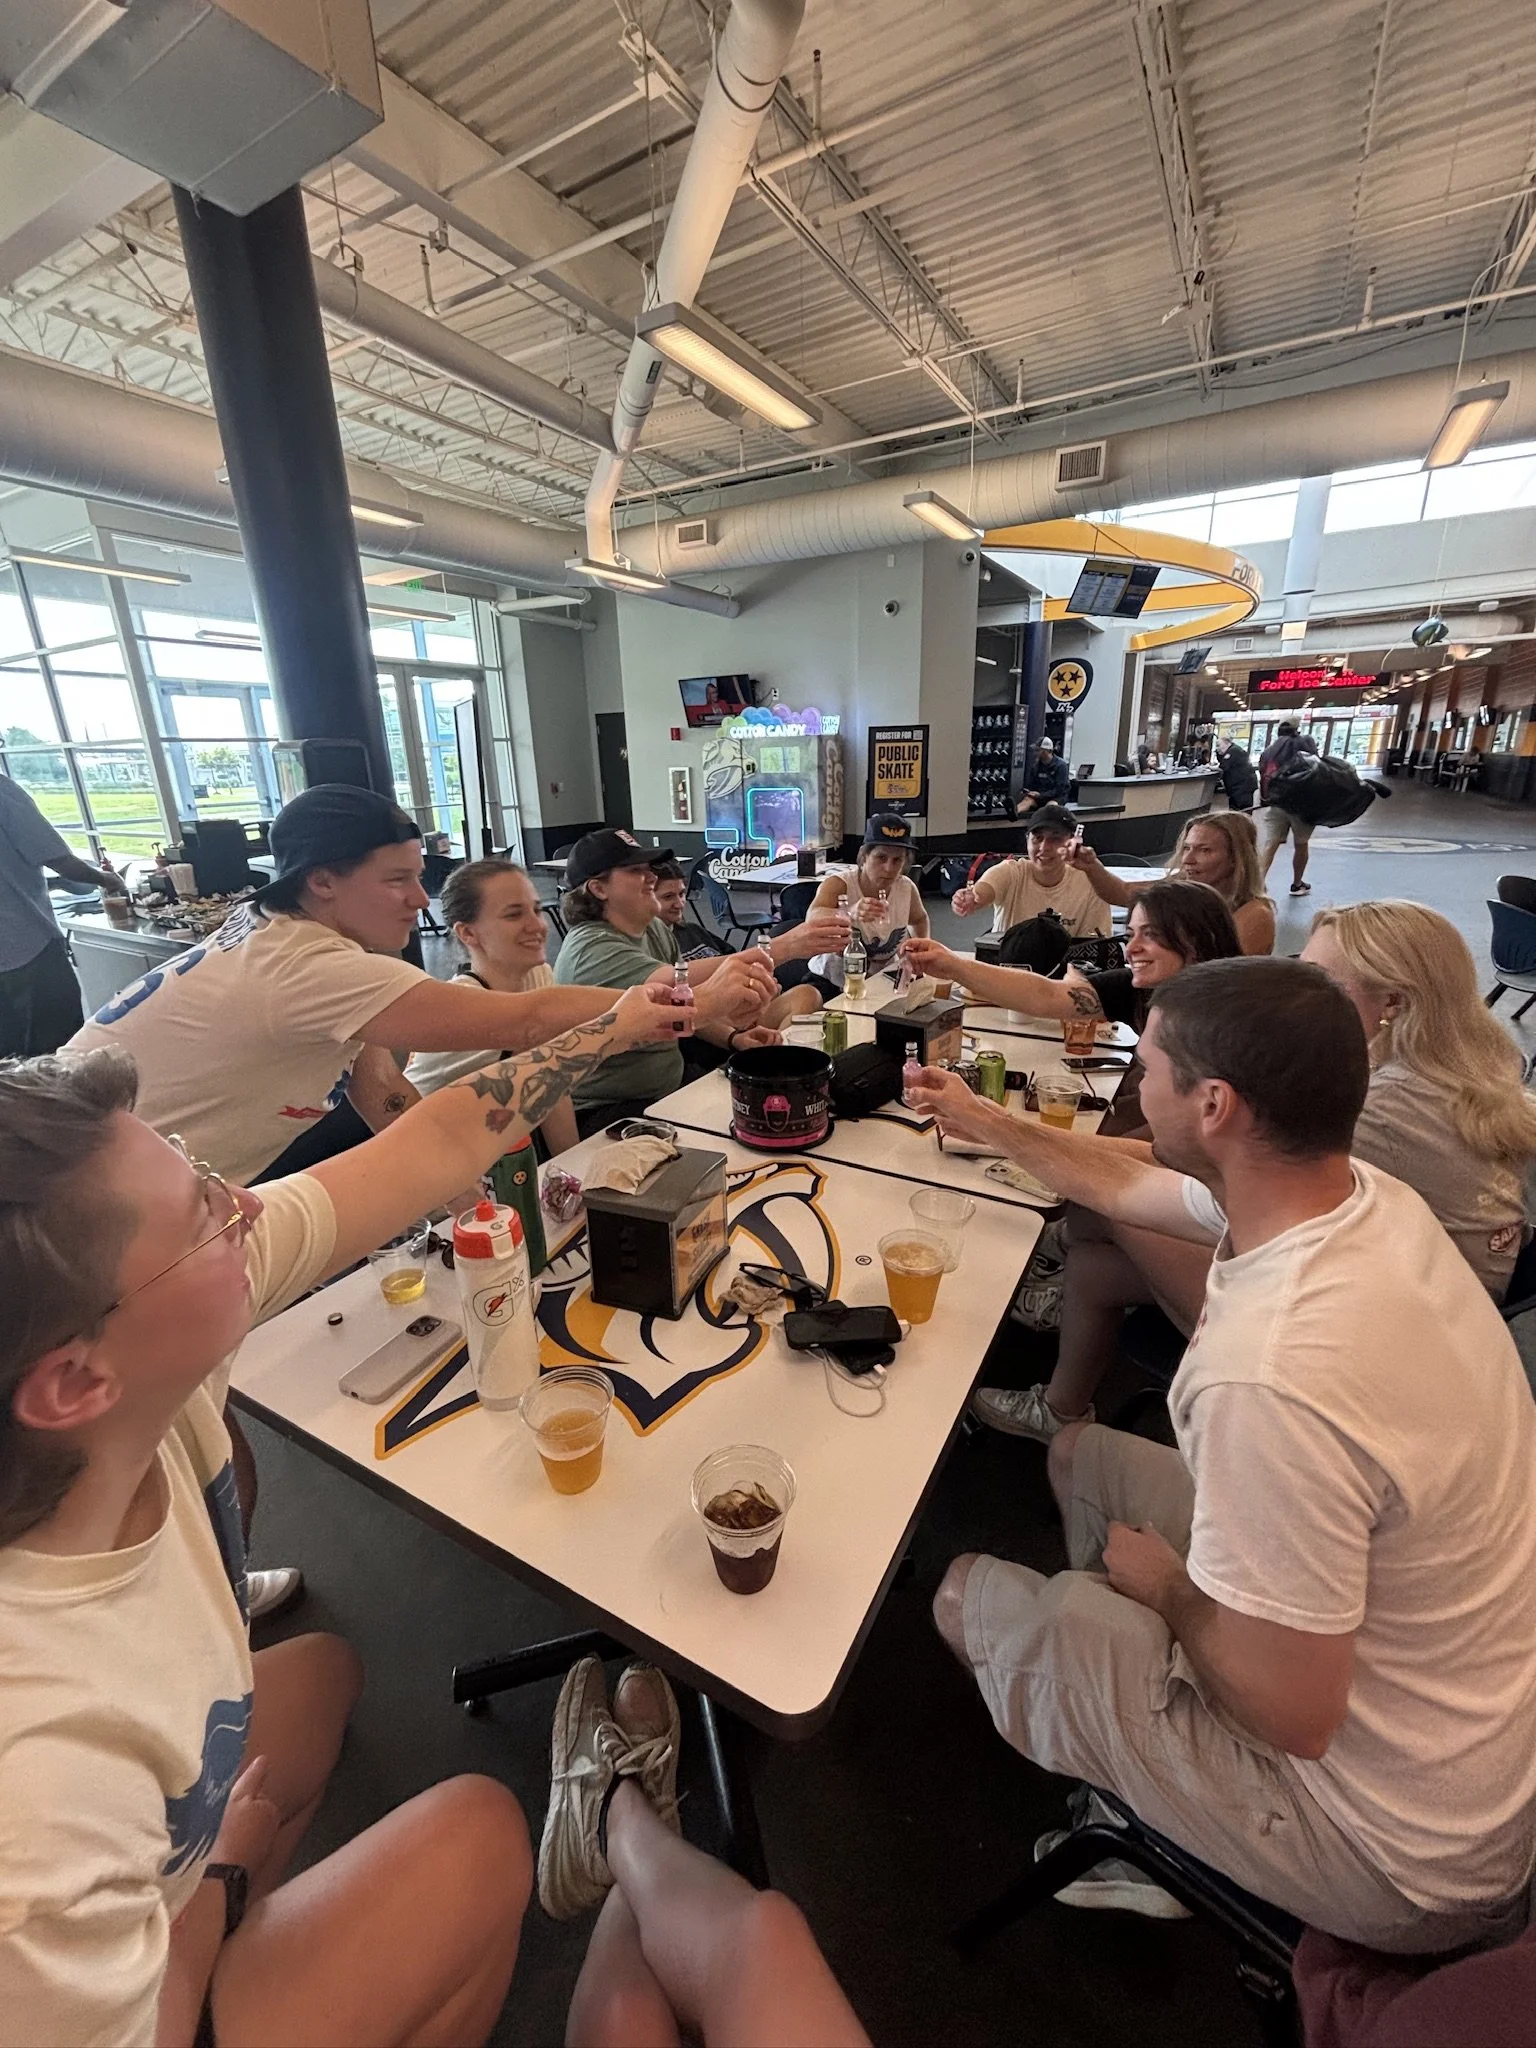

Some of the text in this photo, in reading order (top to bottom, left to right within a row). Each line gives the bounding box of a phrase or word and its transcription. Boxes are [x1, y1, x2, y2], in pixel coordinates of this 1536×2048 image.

[1259, 675, 1377, 690] Ford Ice Center
[766, 724, 806, 737] CANDY
[876, 731, 912, 740] REGISTER FOR
[878, 745, 919, 761] PUBLIC
[878, 762, 914, 779] SKATE
[721, 846, 770, 869] Cotton
[708, 858, 751, 880] Can
